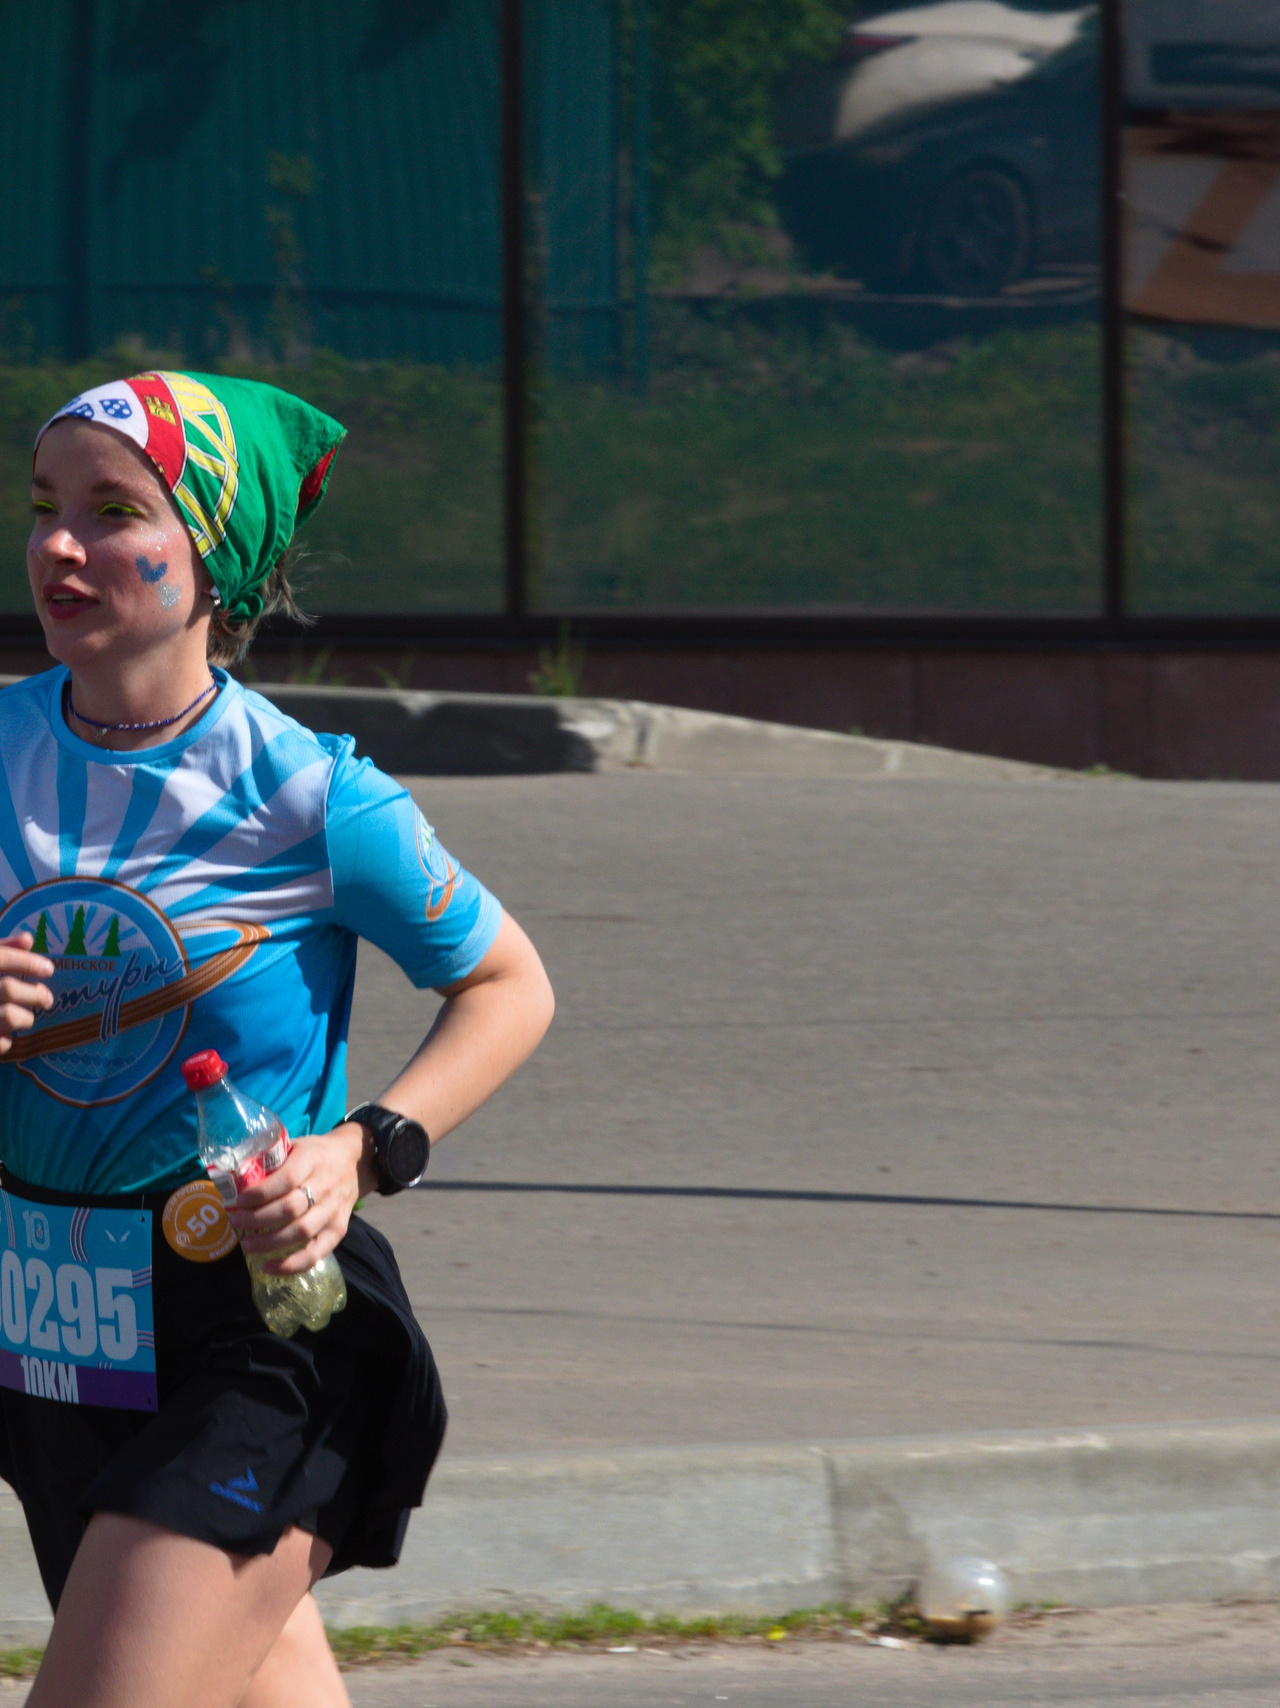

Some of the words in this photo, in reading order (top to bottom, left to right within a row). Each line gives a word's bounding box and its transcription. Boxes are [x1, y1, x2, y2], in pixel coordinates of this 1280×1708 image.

[52, 958, 116, 973] МЕНСКОЕ
[21, 1209, 51, 1251] 10
[186, 1203, 220, 1239] 50
[20, 1354, 80, 1405] 10KM
